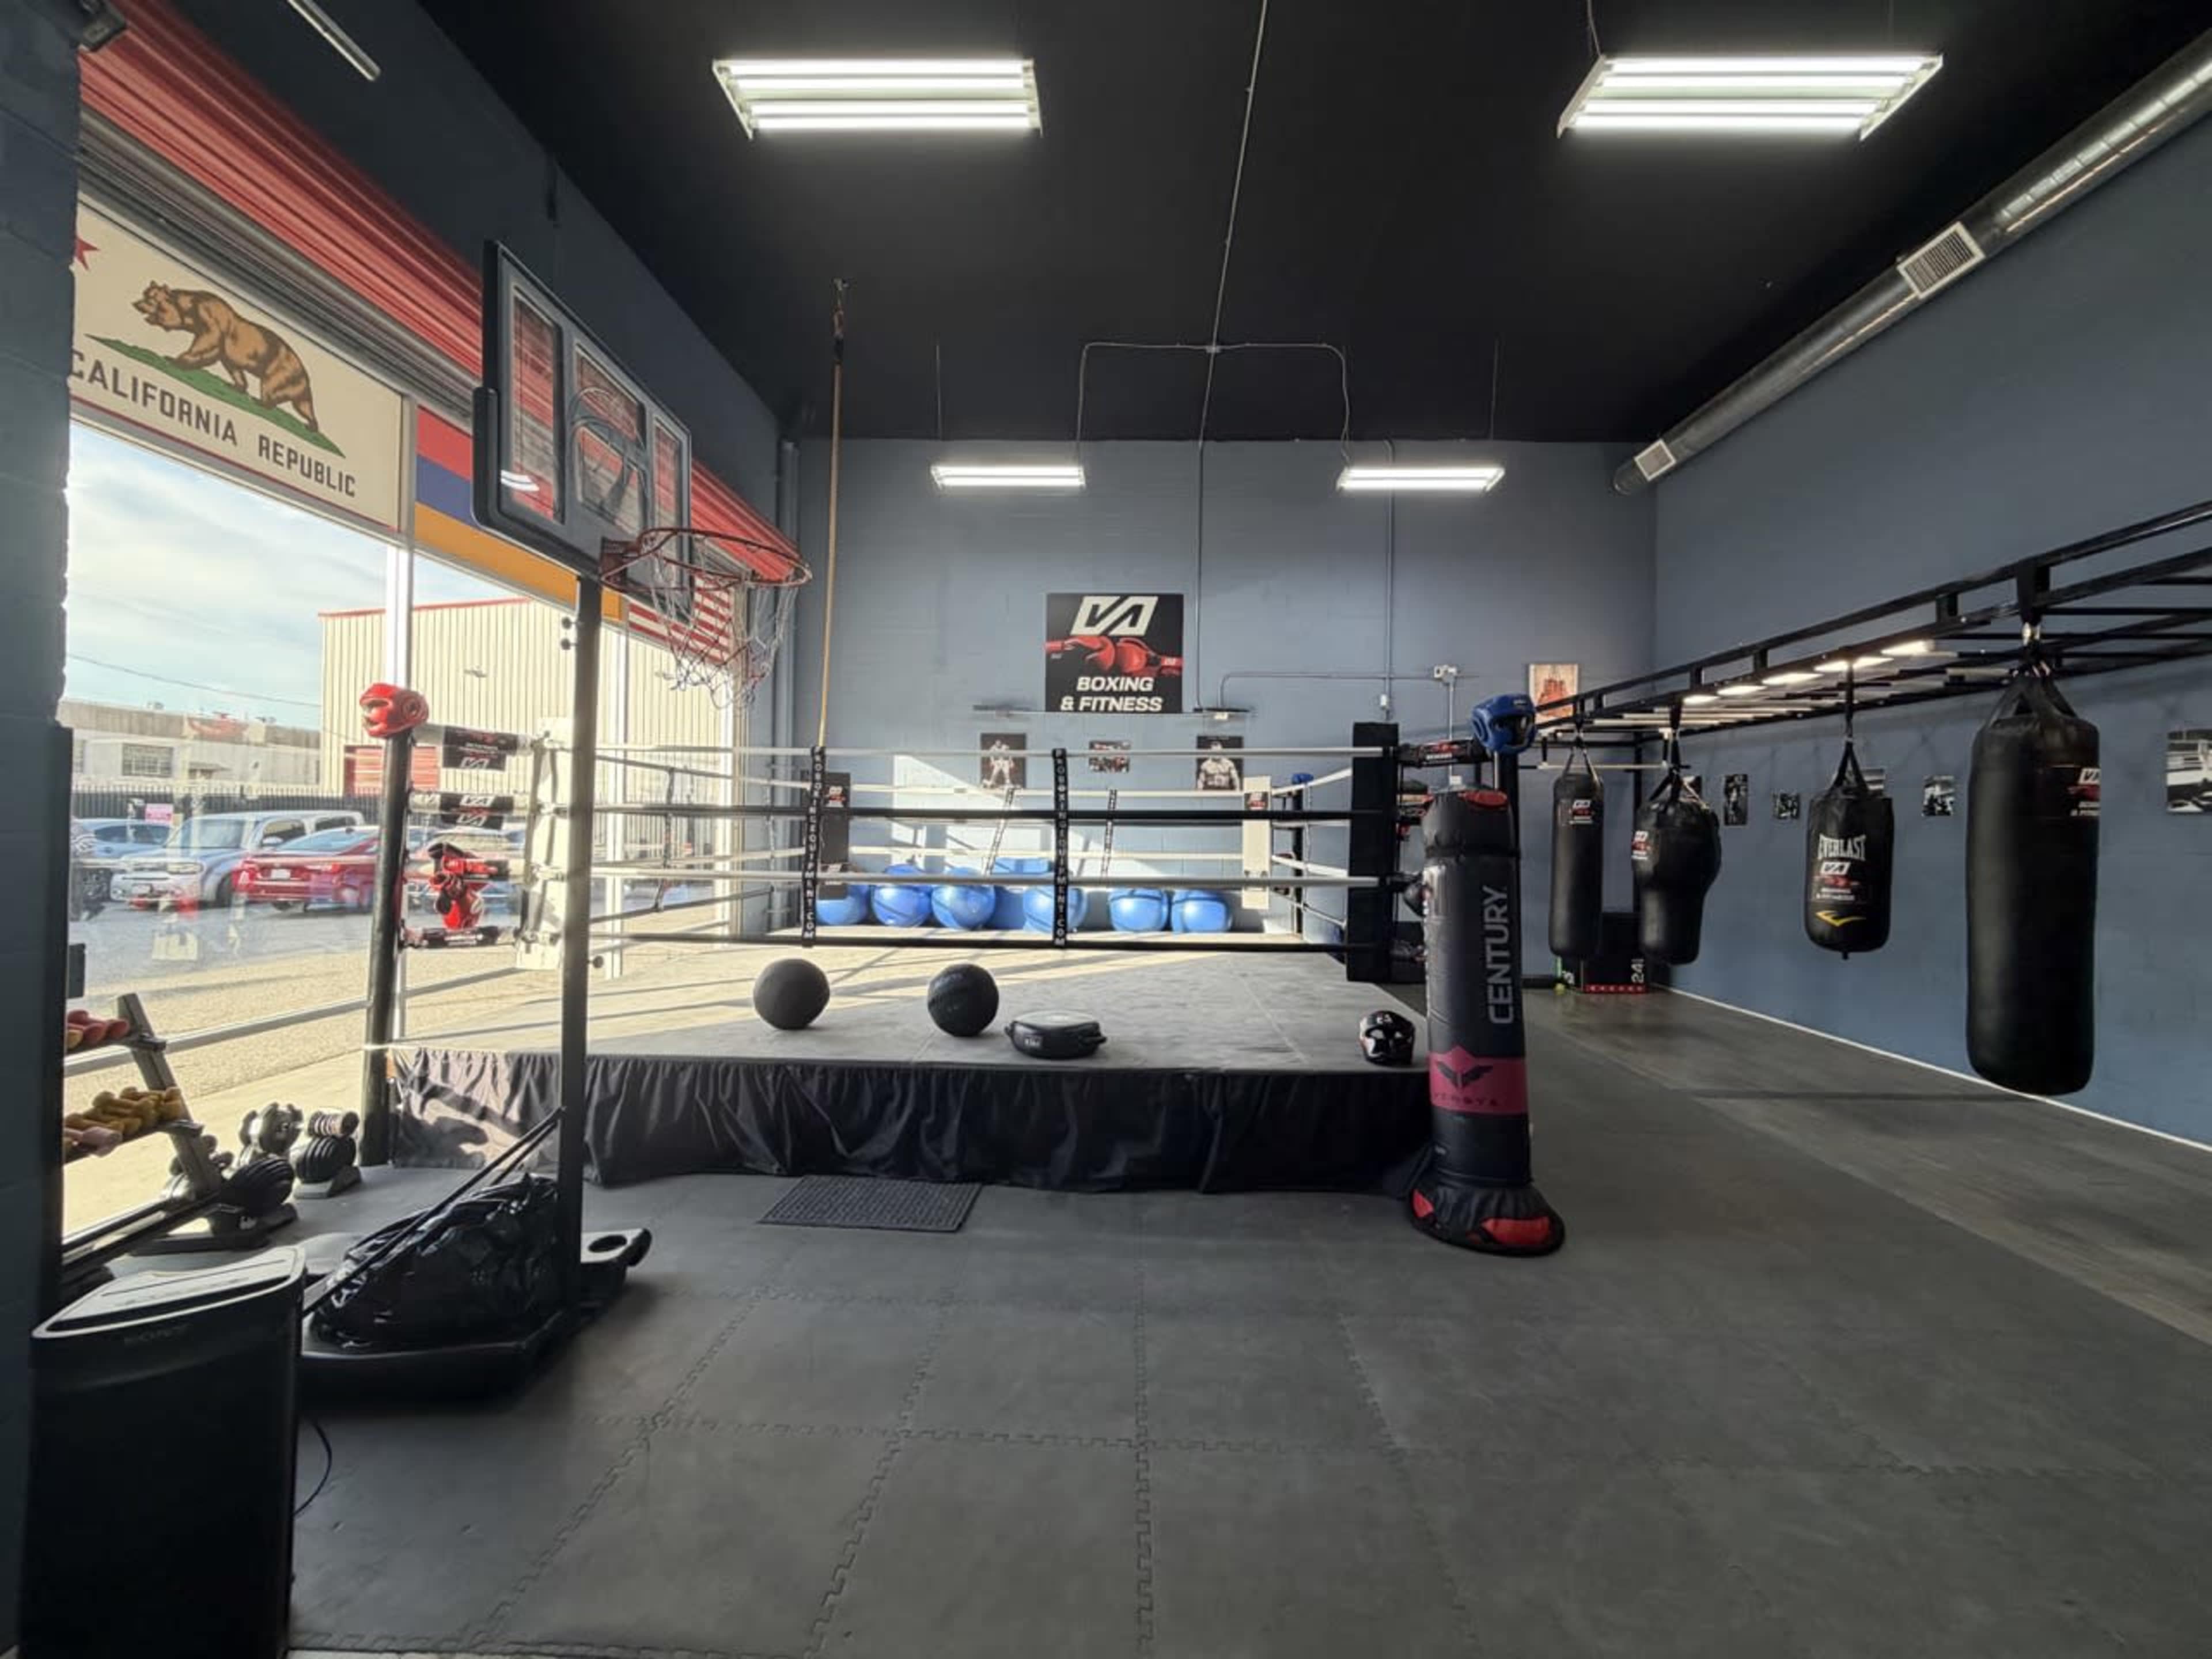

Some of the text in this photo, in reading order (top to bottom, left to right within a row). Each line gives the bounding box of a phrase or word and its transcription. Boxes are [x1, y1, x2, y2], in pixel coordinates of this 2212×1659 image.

[71, 349, 355, 498] CALIFORNIA REPUBLIC
[1076, 676, 1154, 692] BOXING
[1060, 695, 1162, 711] & FITNESS
[1817, 833, 1866, 861] EVERLAST
[1482, 885, 1514, 1024] CENTURY
